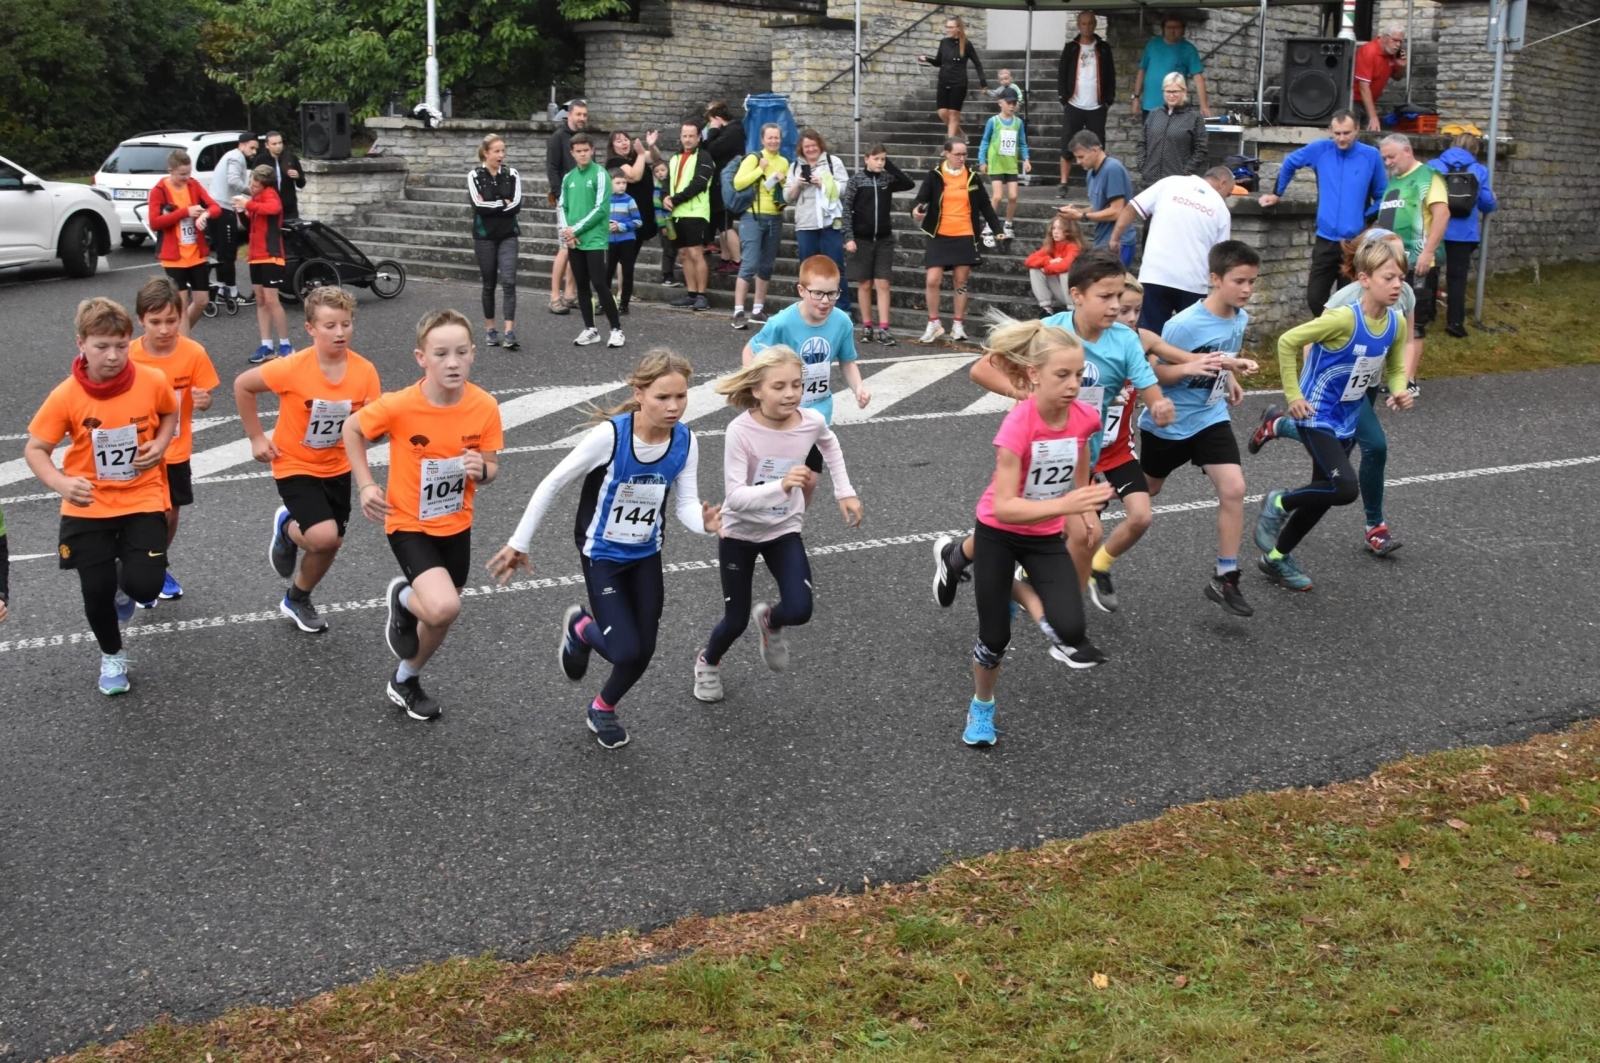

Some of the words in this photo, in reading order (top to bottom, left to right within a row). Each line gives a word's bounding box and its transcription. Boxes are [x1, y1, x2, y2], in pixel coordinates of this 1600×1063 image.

[1002, 139, 1016, 148] 107
[1172, 195, 1216, 217] ROZHODČÍ
[310, 419, 345, 435] 121
[96, 446, 138, 467] 127
[1031, 465, 1074, 486] 122
[423, 478, 464, 501] 104
[612, 505, 656, 526] 144
